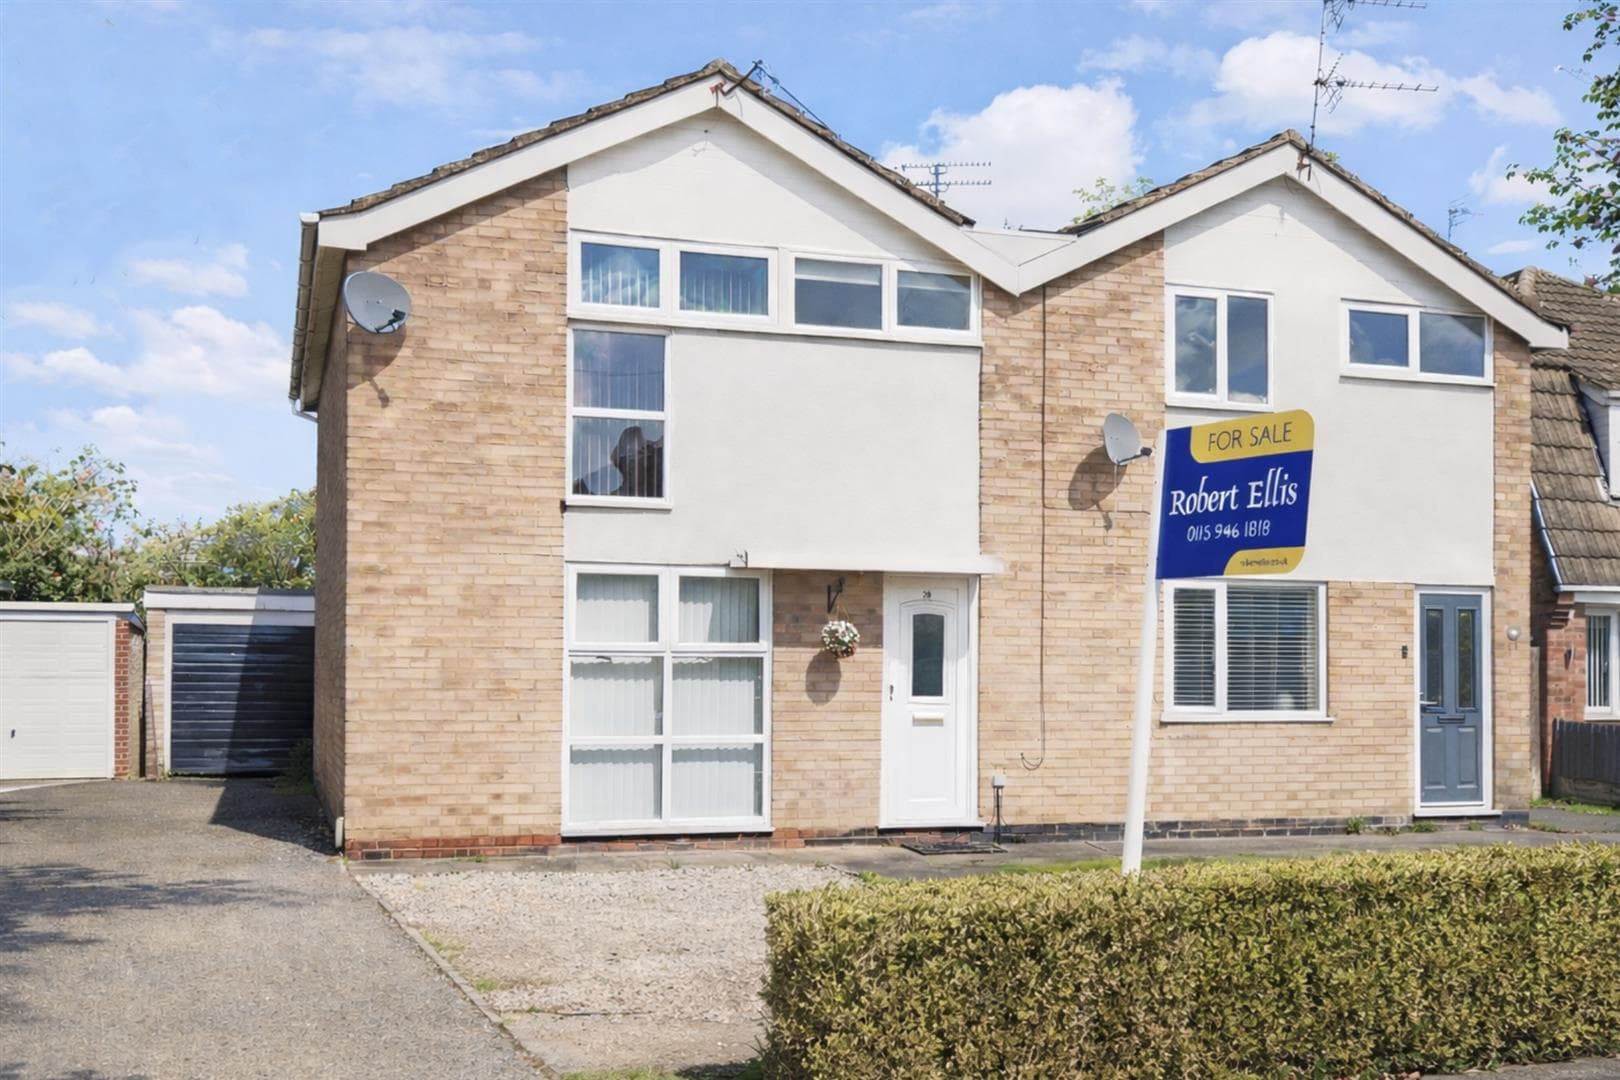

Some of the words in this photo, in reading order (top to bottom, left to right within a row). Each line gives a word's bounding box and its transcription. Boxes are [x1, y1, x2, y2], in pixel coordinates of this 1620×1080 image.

[1208, 429, 1242, 451] FOR
[1250, 422, 1292, 447] SALE
[1169, 476, 1239, 516] Robert
[1247, 467, 1298, 508] Ellis
[1187, 526, 1211, 542] 0115
[1214, 524, 1239, 538] 946
[1244, 520, 1270, 537] 1818
